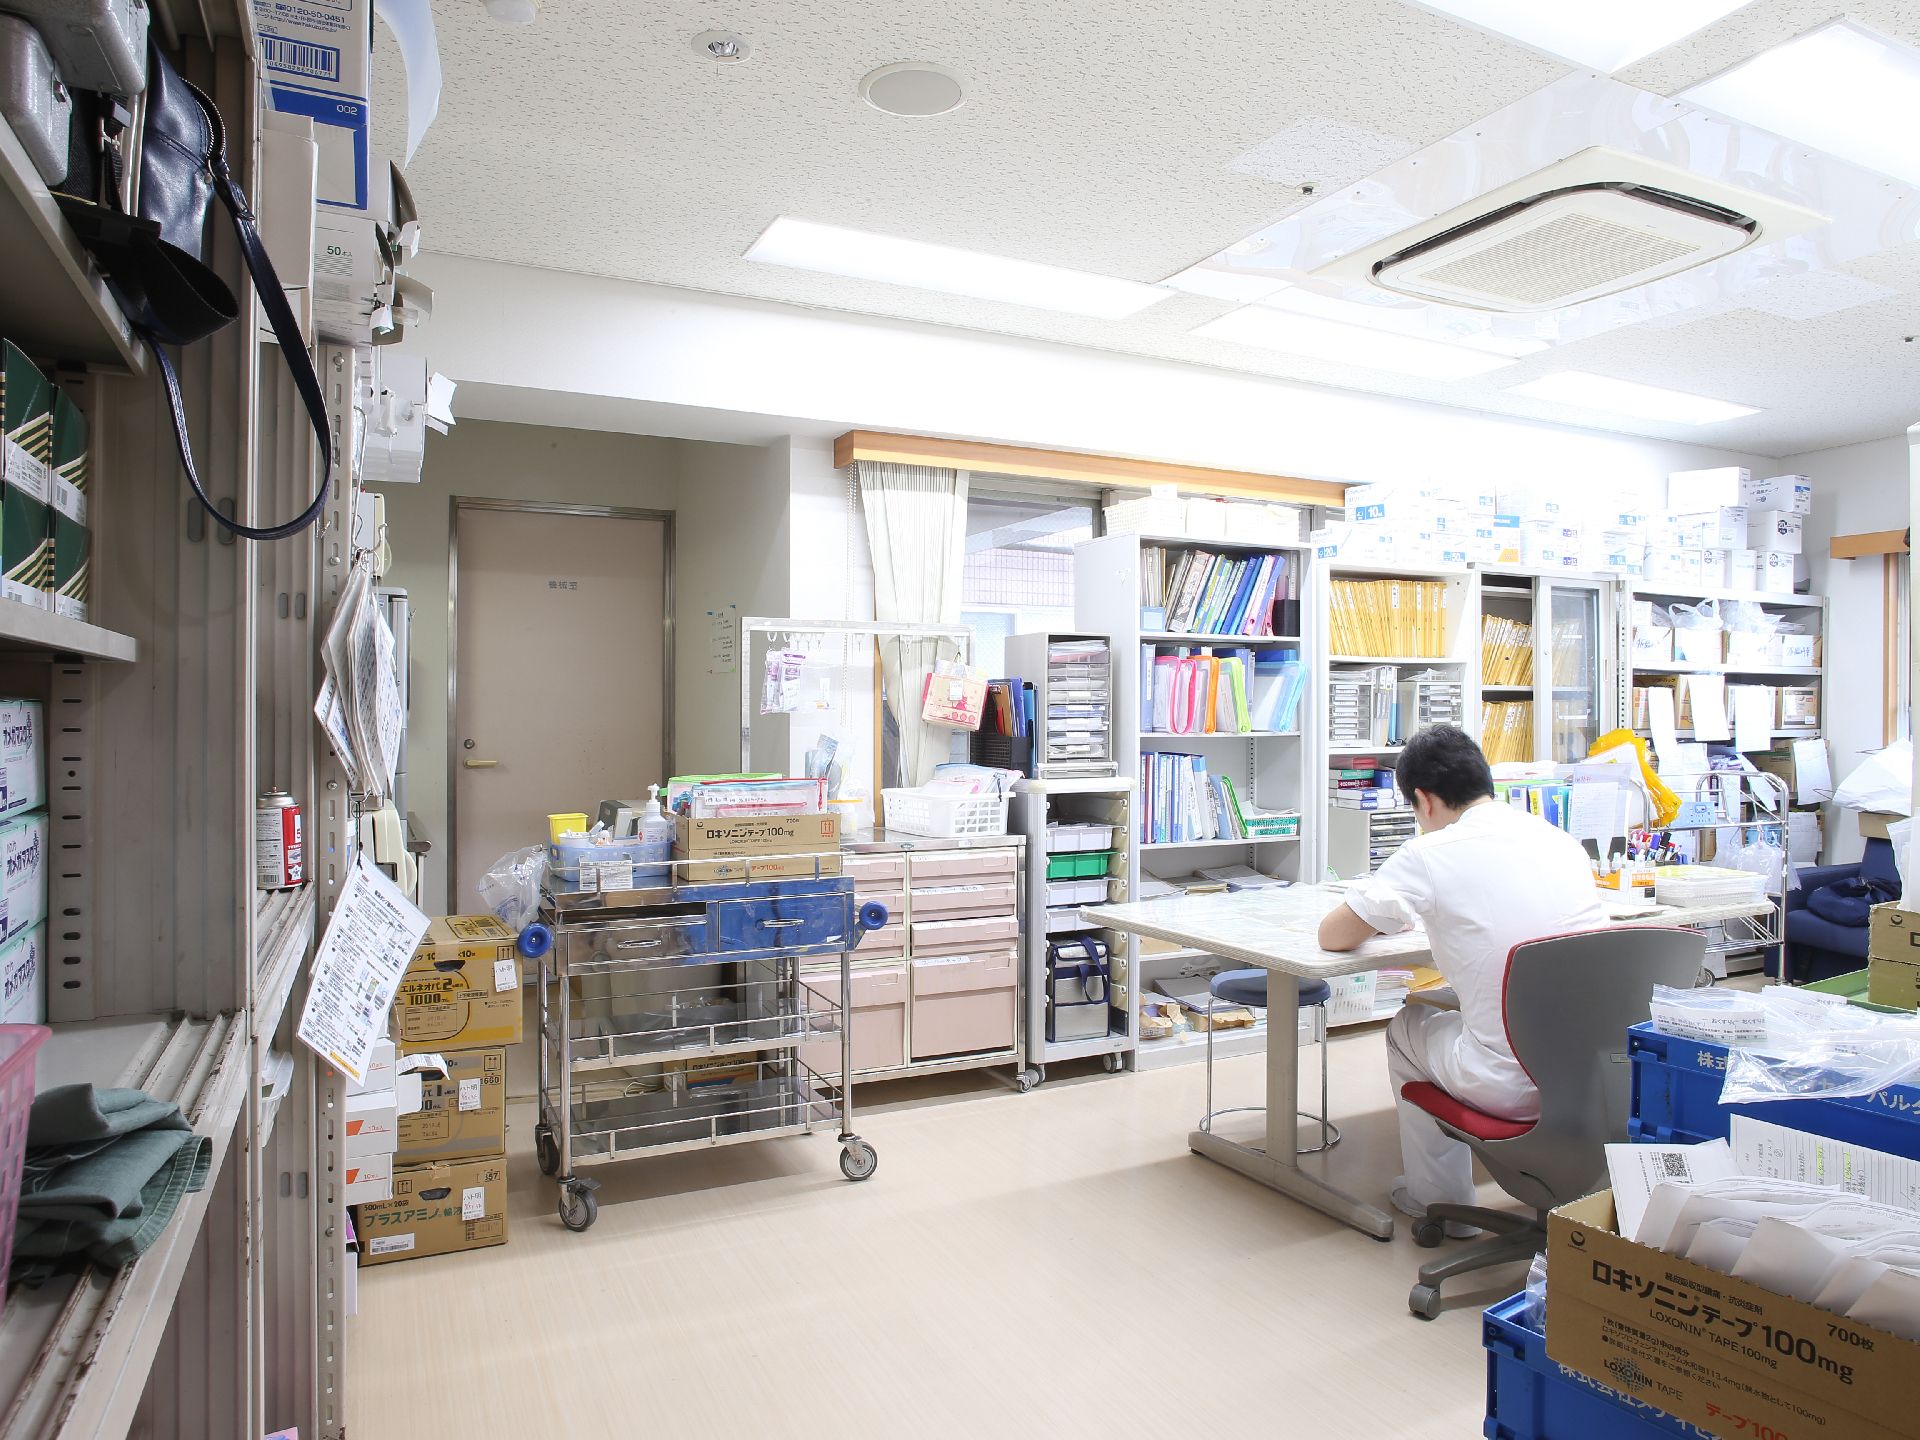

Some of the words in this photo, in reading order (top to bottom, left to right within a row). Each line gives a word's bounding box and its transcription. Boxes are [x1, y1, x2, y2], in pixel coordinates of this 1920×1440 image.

[336, 104, 358, 116] 002
[1708, 1331, 1739, 1353] TAPE
[1741, 1345, 1778, 1370] 100mg
[1827, 1322, 1875, 1352] 700枚
[1603, 1359, 1653, 1388] LOXONIN
[1656, 1381, 1683, 1401] TAPE
